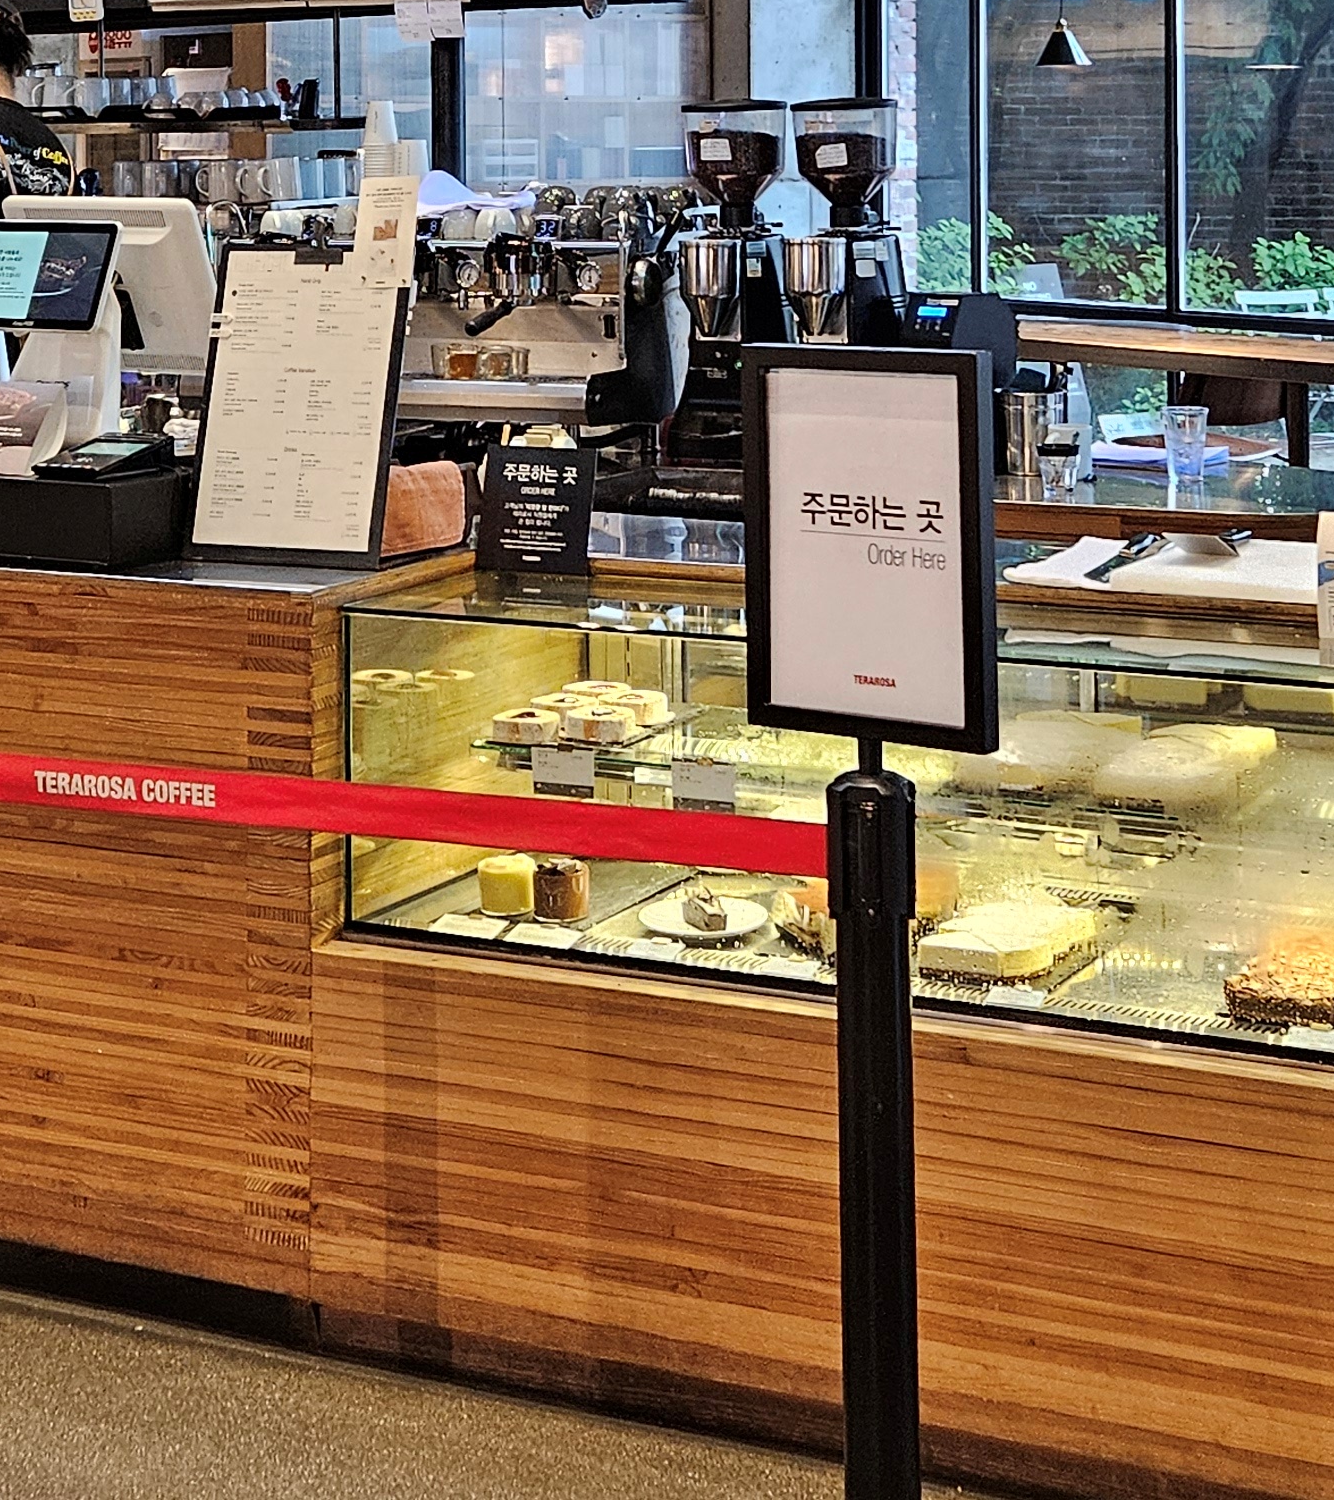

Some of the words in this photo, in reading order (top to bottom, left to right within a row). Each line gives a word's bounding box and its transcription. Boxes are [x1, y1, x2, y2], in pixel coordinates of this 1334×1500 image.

[503, 463, 559, 483] 주문하는
[562, 466, 578, 485] 곳
[801, 492, 907, 531] 주문하는
[917, 500, 944, 534] 곳
[867, 543, 907, 567] Order
[911, 547, 946, 571] Here
[854, 674, 896, 688] TERAROSA
[34, 770, 137, 801] TERAROSA
[142, 779, 216, 808] COFFEE
